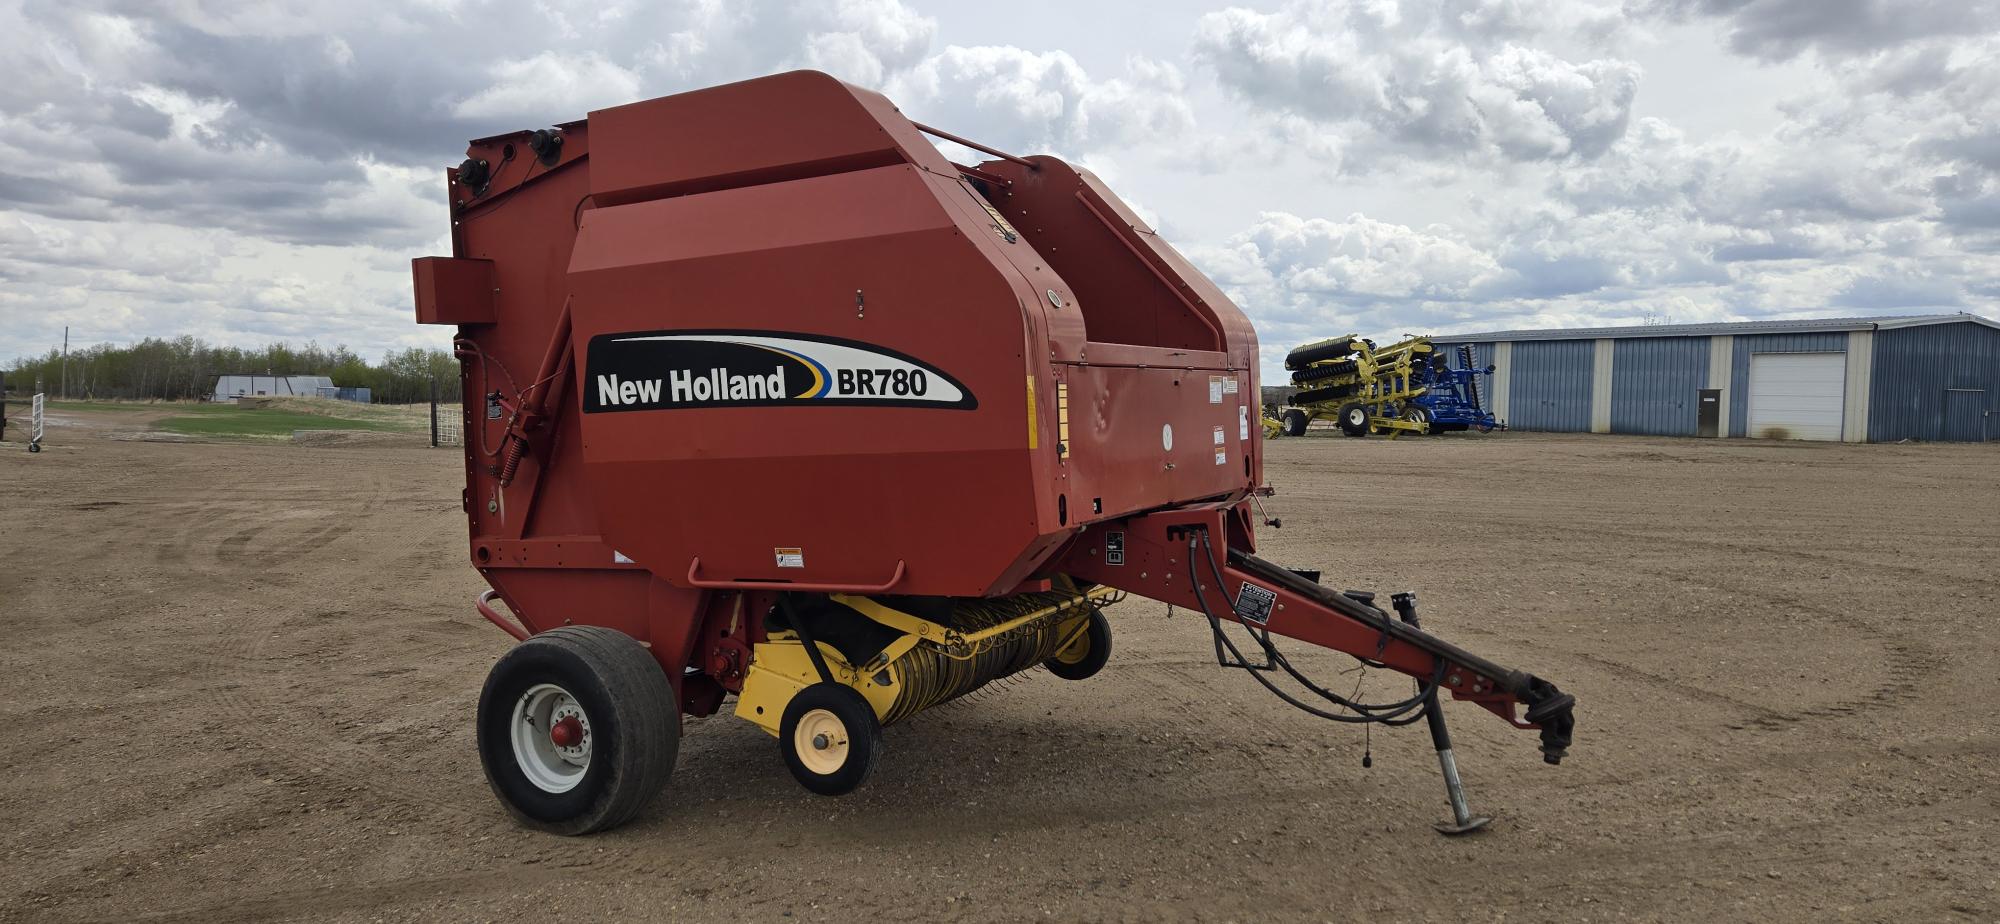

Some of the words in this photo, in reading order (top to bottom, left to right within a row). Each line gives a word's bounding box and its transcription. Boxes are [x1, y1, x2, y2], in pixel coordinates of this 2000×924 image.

[598, 374, 662, 406] New
[670, 365, 786, 401] Holland
[838, 369, 927, 397] BR780
[1246, 584, 1273, 598] ATTENTION
